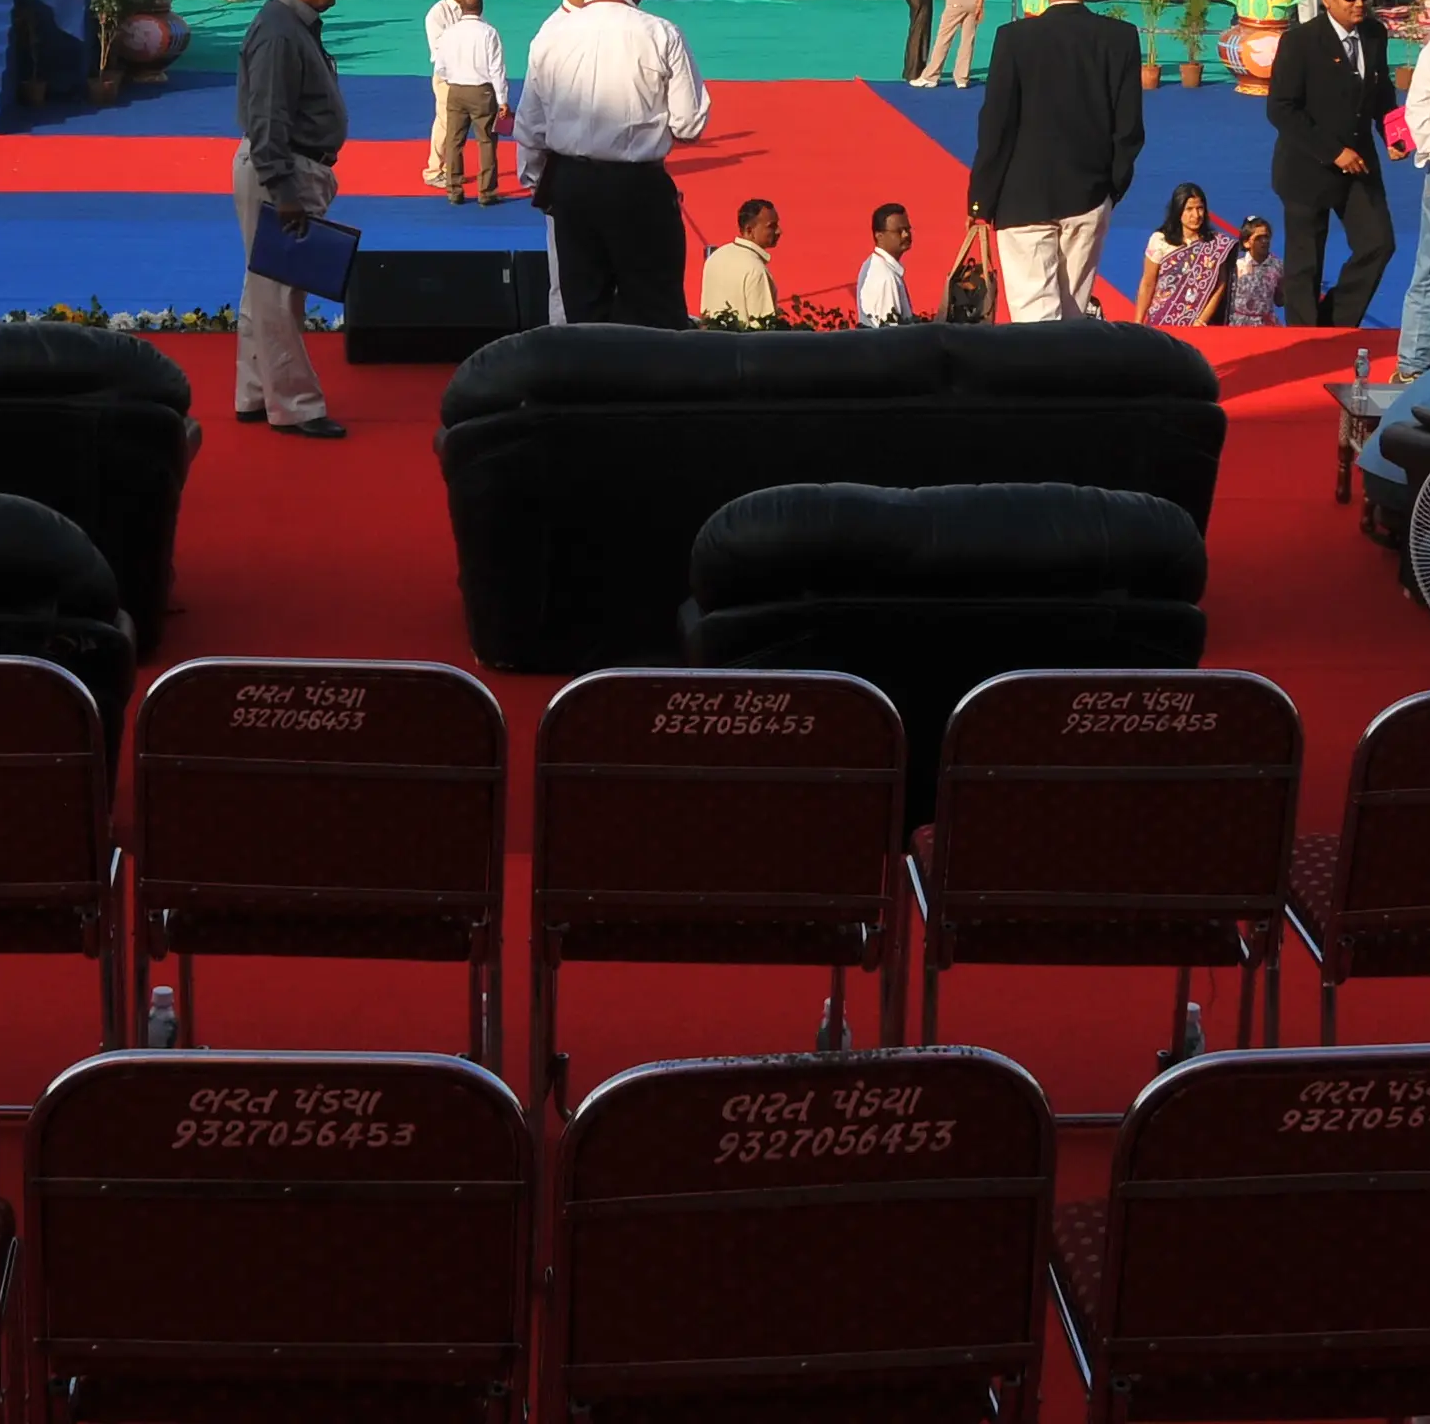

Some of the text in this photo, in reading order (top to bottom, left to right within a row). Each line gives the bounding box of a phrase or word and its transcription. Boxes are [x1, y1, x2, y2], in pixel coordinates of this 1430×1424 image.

[236, 684, 295, 705] ભરત
[666, 691, 723, 712] ભરત
[1071, 690, 1134, 711] ભરત
[229, 708, 366, 732] 9327056453
[650, 714, 816, 736] 9327056453
[1060, 713, 1218, 736] 9327056453
[188, 1087, 279, 1115] ભરત
[1299, 1080, 1376, 1105] ભરત
[720, 1090, 816, 1124] ભરત
[170, 1118, 417, 1150] 9327056453
[712, 1119, 958, 1165] 9327056453
